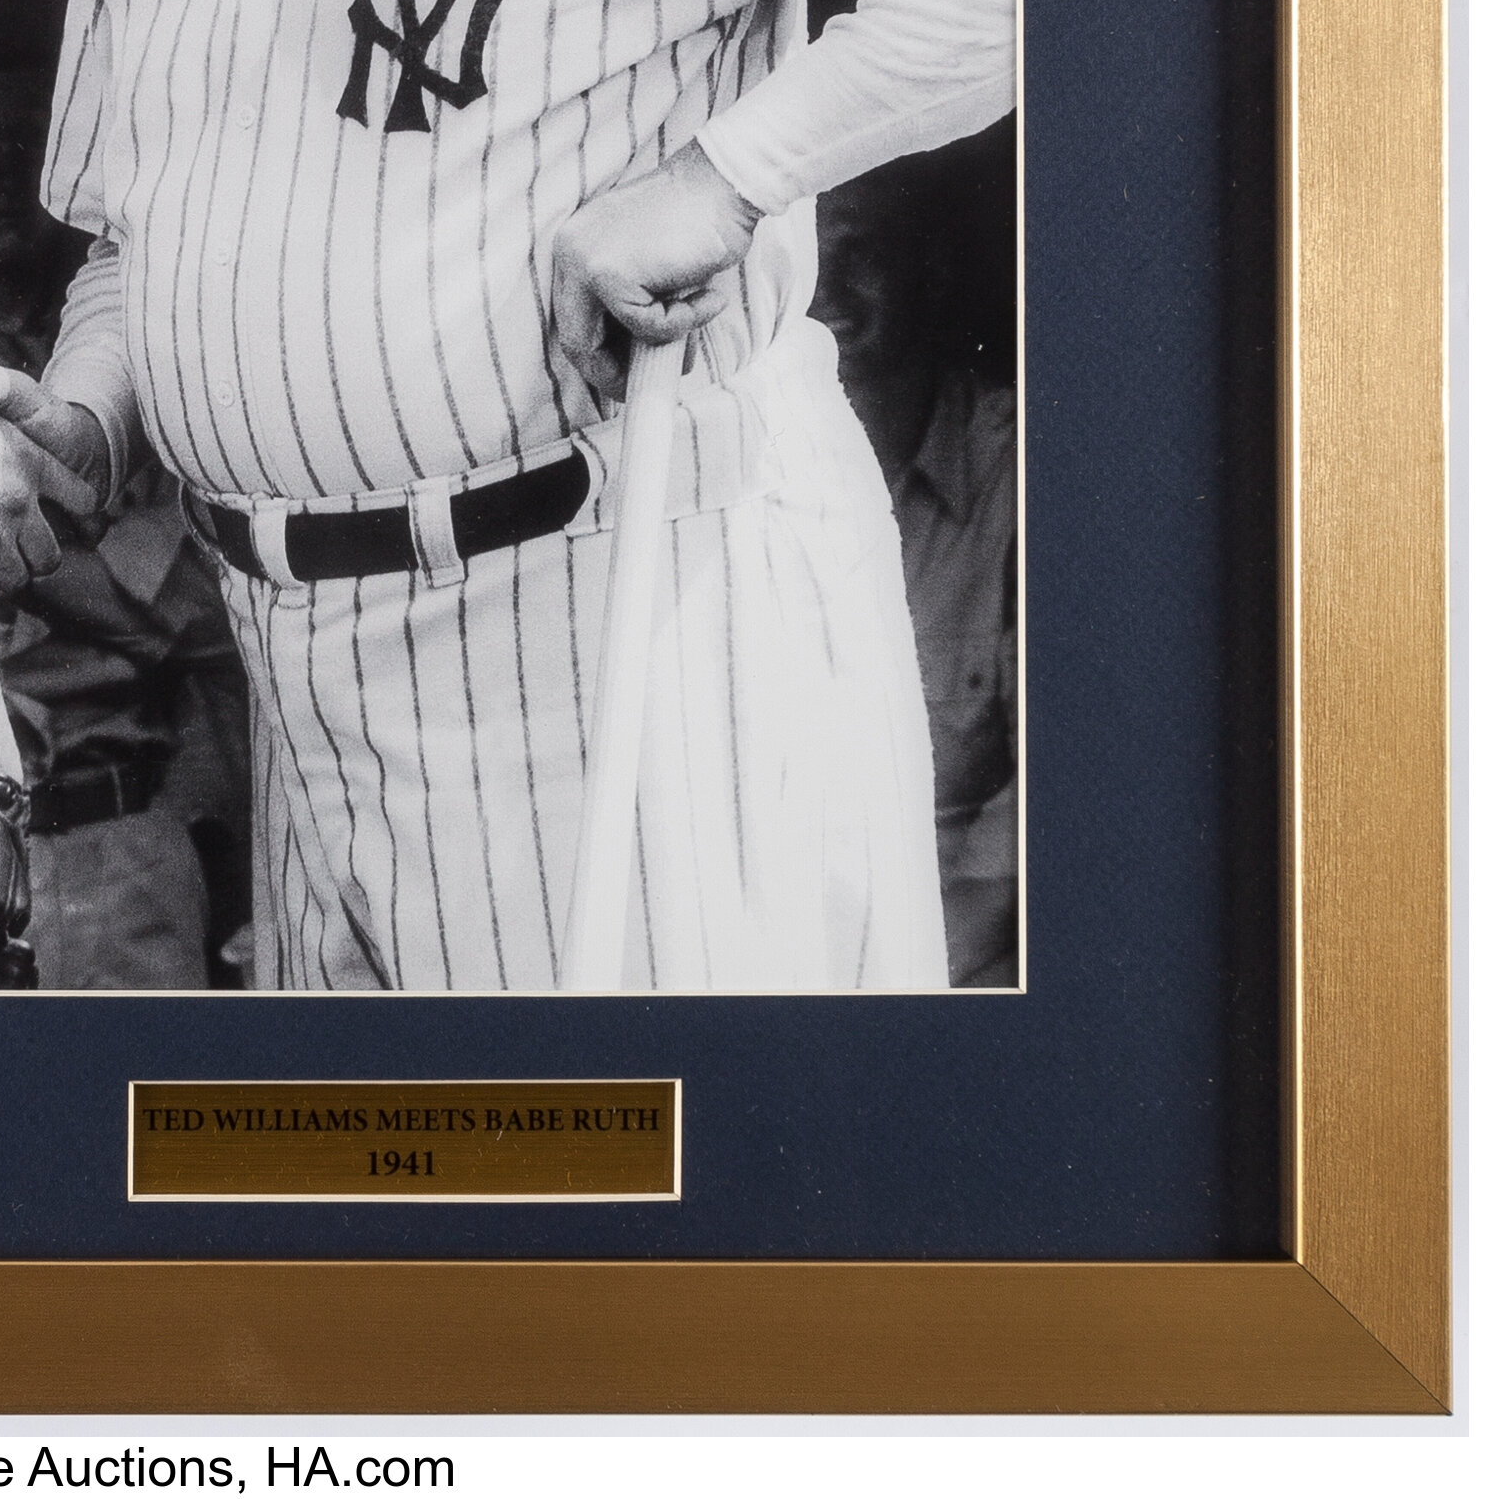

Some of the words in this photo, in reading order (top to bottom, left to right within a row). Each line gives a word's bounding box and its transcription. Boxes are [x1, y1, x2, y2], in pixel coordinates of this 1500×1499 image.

[142, 1108, 205, 1132] TED
[213, 1107, 368, 1132] WILLIAMS
[376, 1108, 477, 1132] MEETS
[484, 1107, 565, 1131] BABE
[572, 1107, 661, 1131] RUTH
[367, 1150, 435, 1176] 1941
